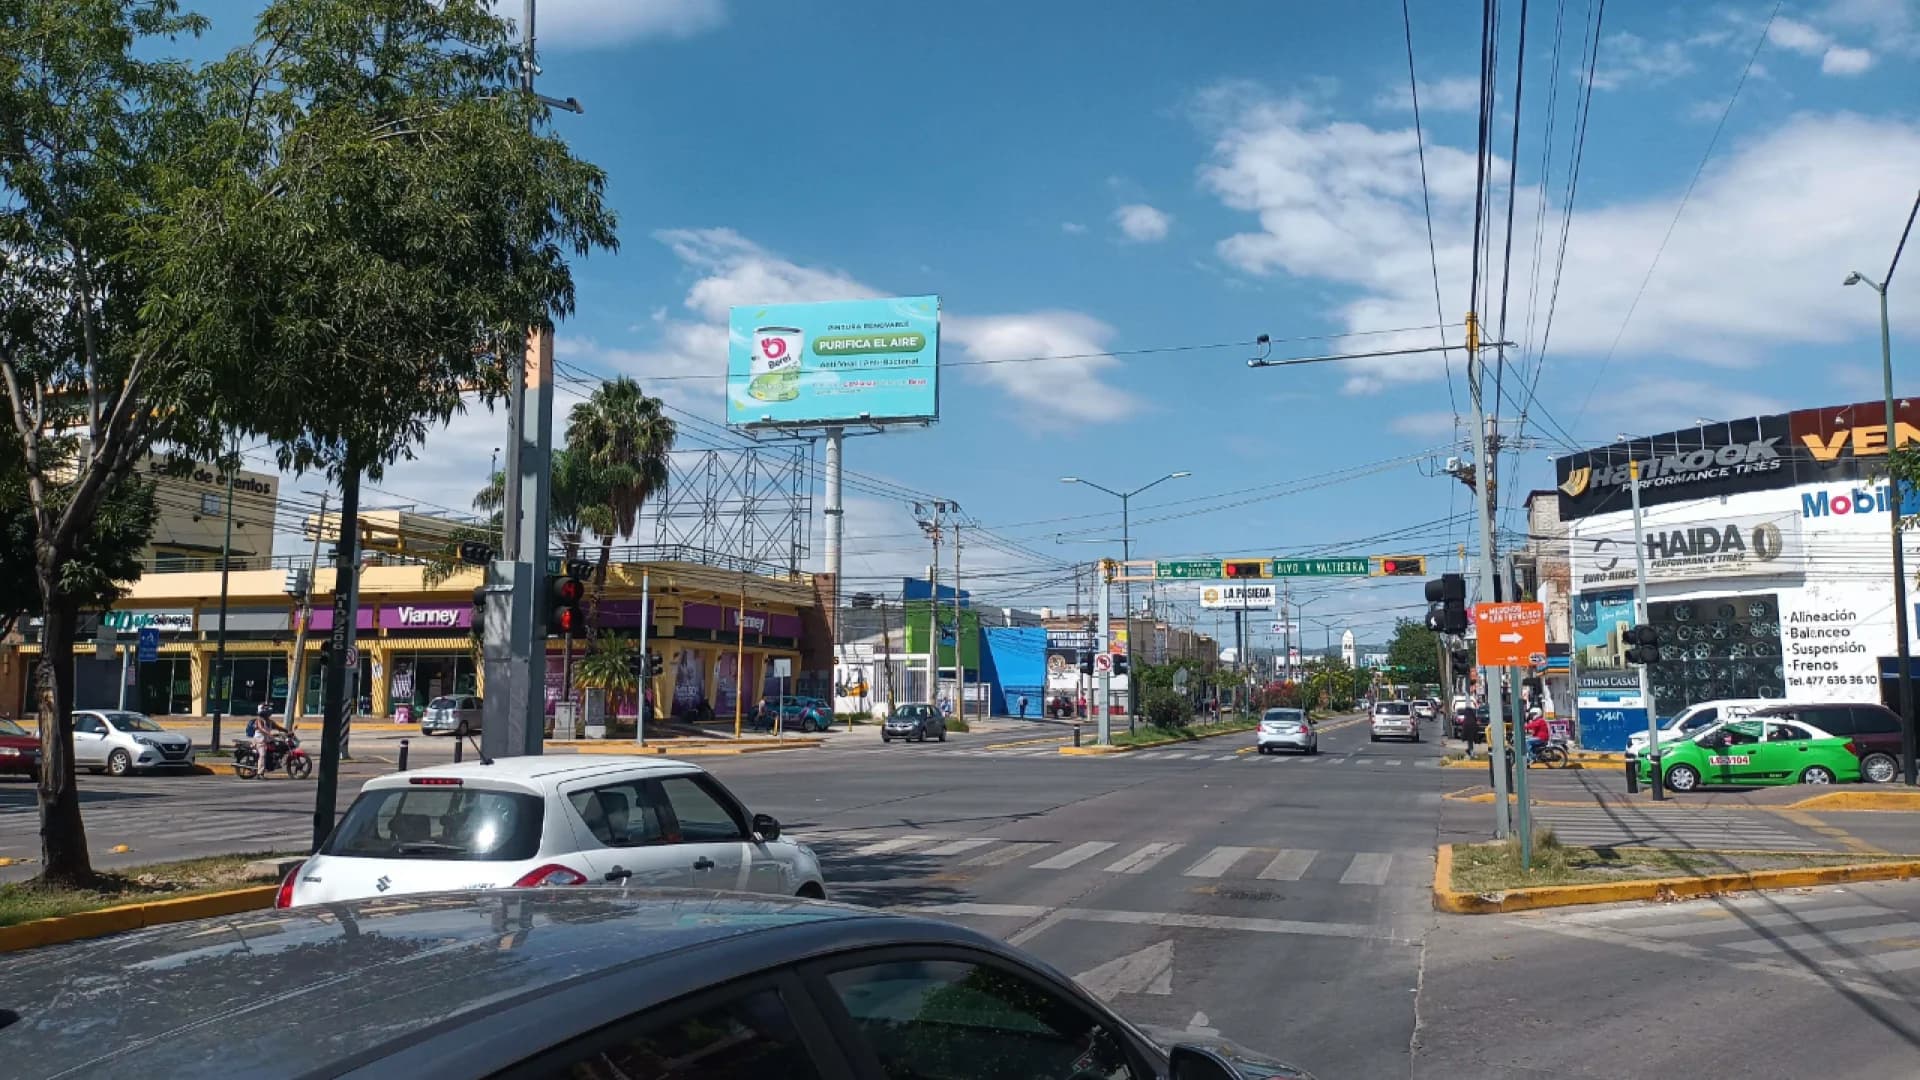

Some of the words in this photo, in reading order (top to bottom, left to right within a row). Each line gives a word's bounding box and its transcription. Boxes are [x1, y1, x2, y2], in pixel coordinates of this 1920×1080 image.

[819, 339, 871, 351] PURIFICA
[874, 338, 887, 347] EL
[890, 336, 918, 347] AIRE
[1622, 467, 1729, 493] PRFORMANCE
[1735, 459, 1781, 474] TIRES
[1646, 524, 1746, 559] HAIDA
[1316, 561, 1365, 573] VALTIERRA
[1651, 555, 1715, 569] PERFORMANCE
[1583, 571, 1608, 584] EURO
[1223, 588, 1233, 598] LA
[398, 606, 459, 626] Vianney
[734, 611, 764, 632] Vanney
[1790, 608, 1857, 623] Alineación
[1792, 641, 1867, 657] Suspensión
[1792, 660, 1839, 671] Frenos
[1806, 676, 1824, 685] 477
[1827, 675, 1847, 685] 636
[1849, 675, 1864, 685] 36
[1866, 675, 1878, 685] 10
